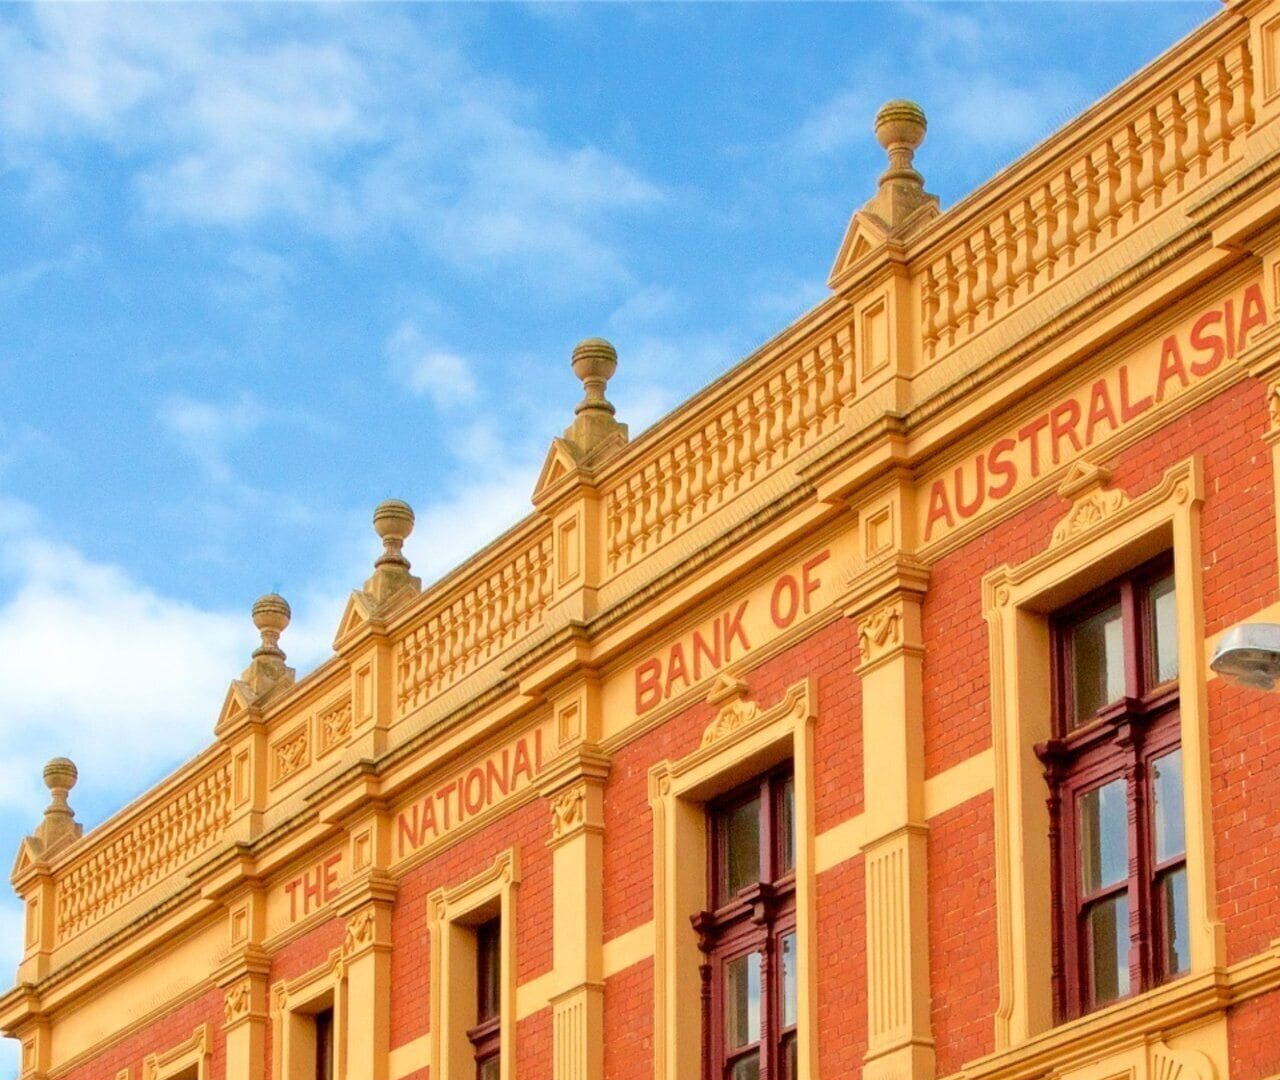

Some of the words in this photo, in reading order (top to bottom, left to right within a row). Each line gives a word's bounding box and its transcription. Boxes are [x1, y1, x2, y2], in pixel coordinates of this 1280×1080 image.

[285, 852, 342, 922] THE
[635, 599, 751, 716] BANK
[770, 549, 831, 629] OF
[923, 282, 1267, 543] AUSTRALASIA
